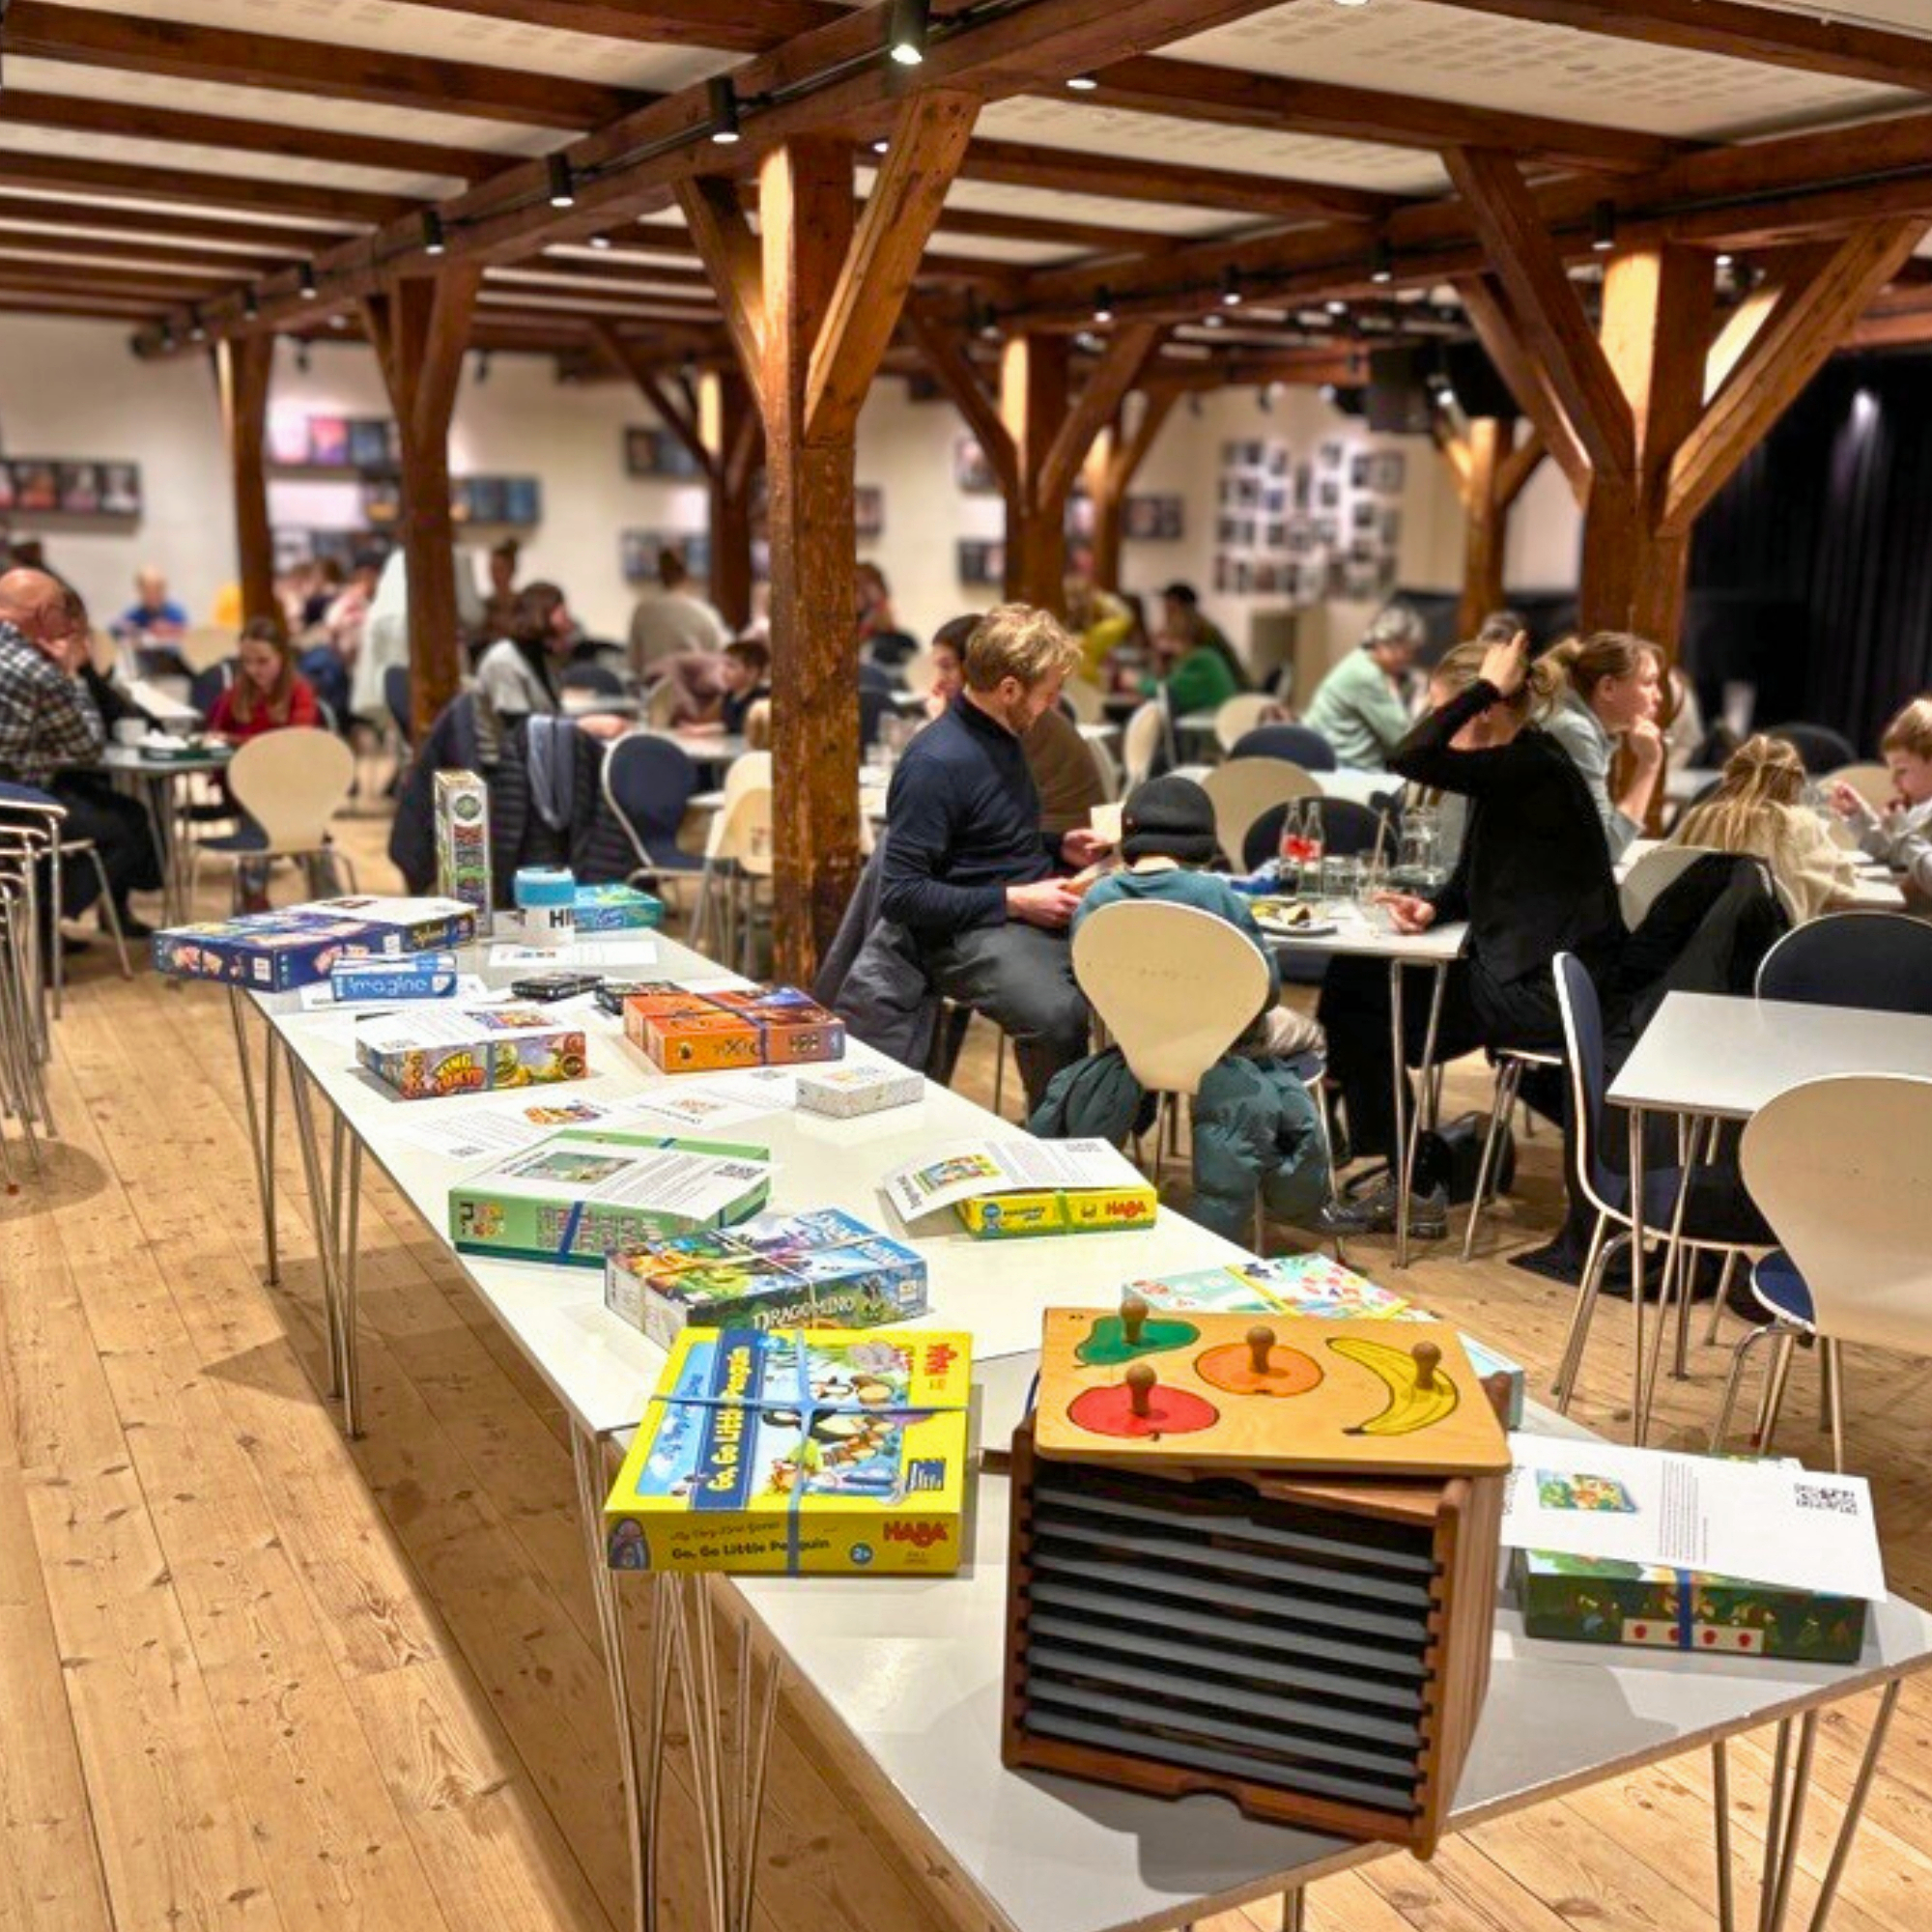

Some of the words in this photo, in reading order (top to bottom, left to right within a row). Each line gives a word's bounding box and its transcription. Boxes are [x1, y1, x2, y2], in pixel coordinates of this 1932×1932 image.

[1105, 1201, 1148, 1218] HABA
[882, 1520, 949, 1548] HABA
[699, 1545, 720, 1557] Go
[724, 1543, 766, 1555] Little
